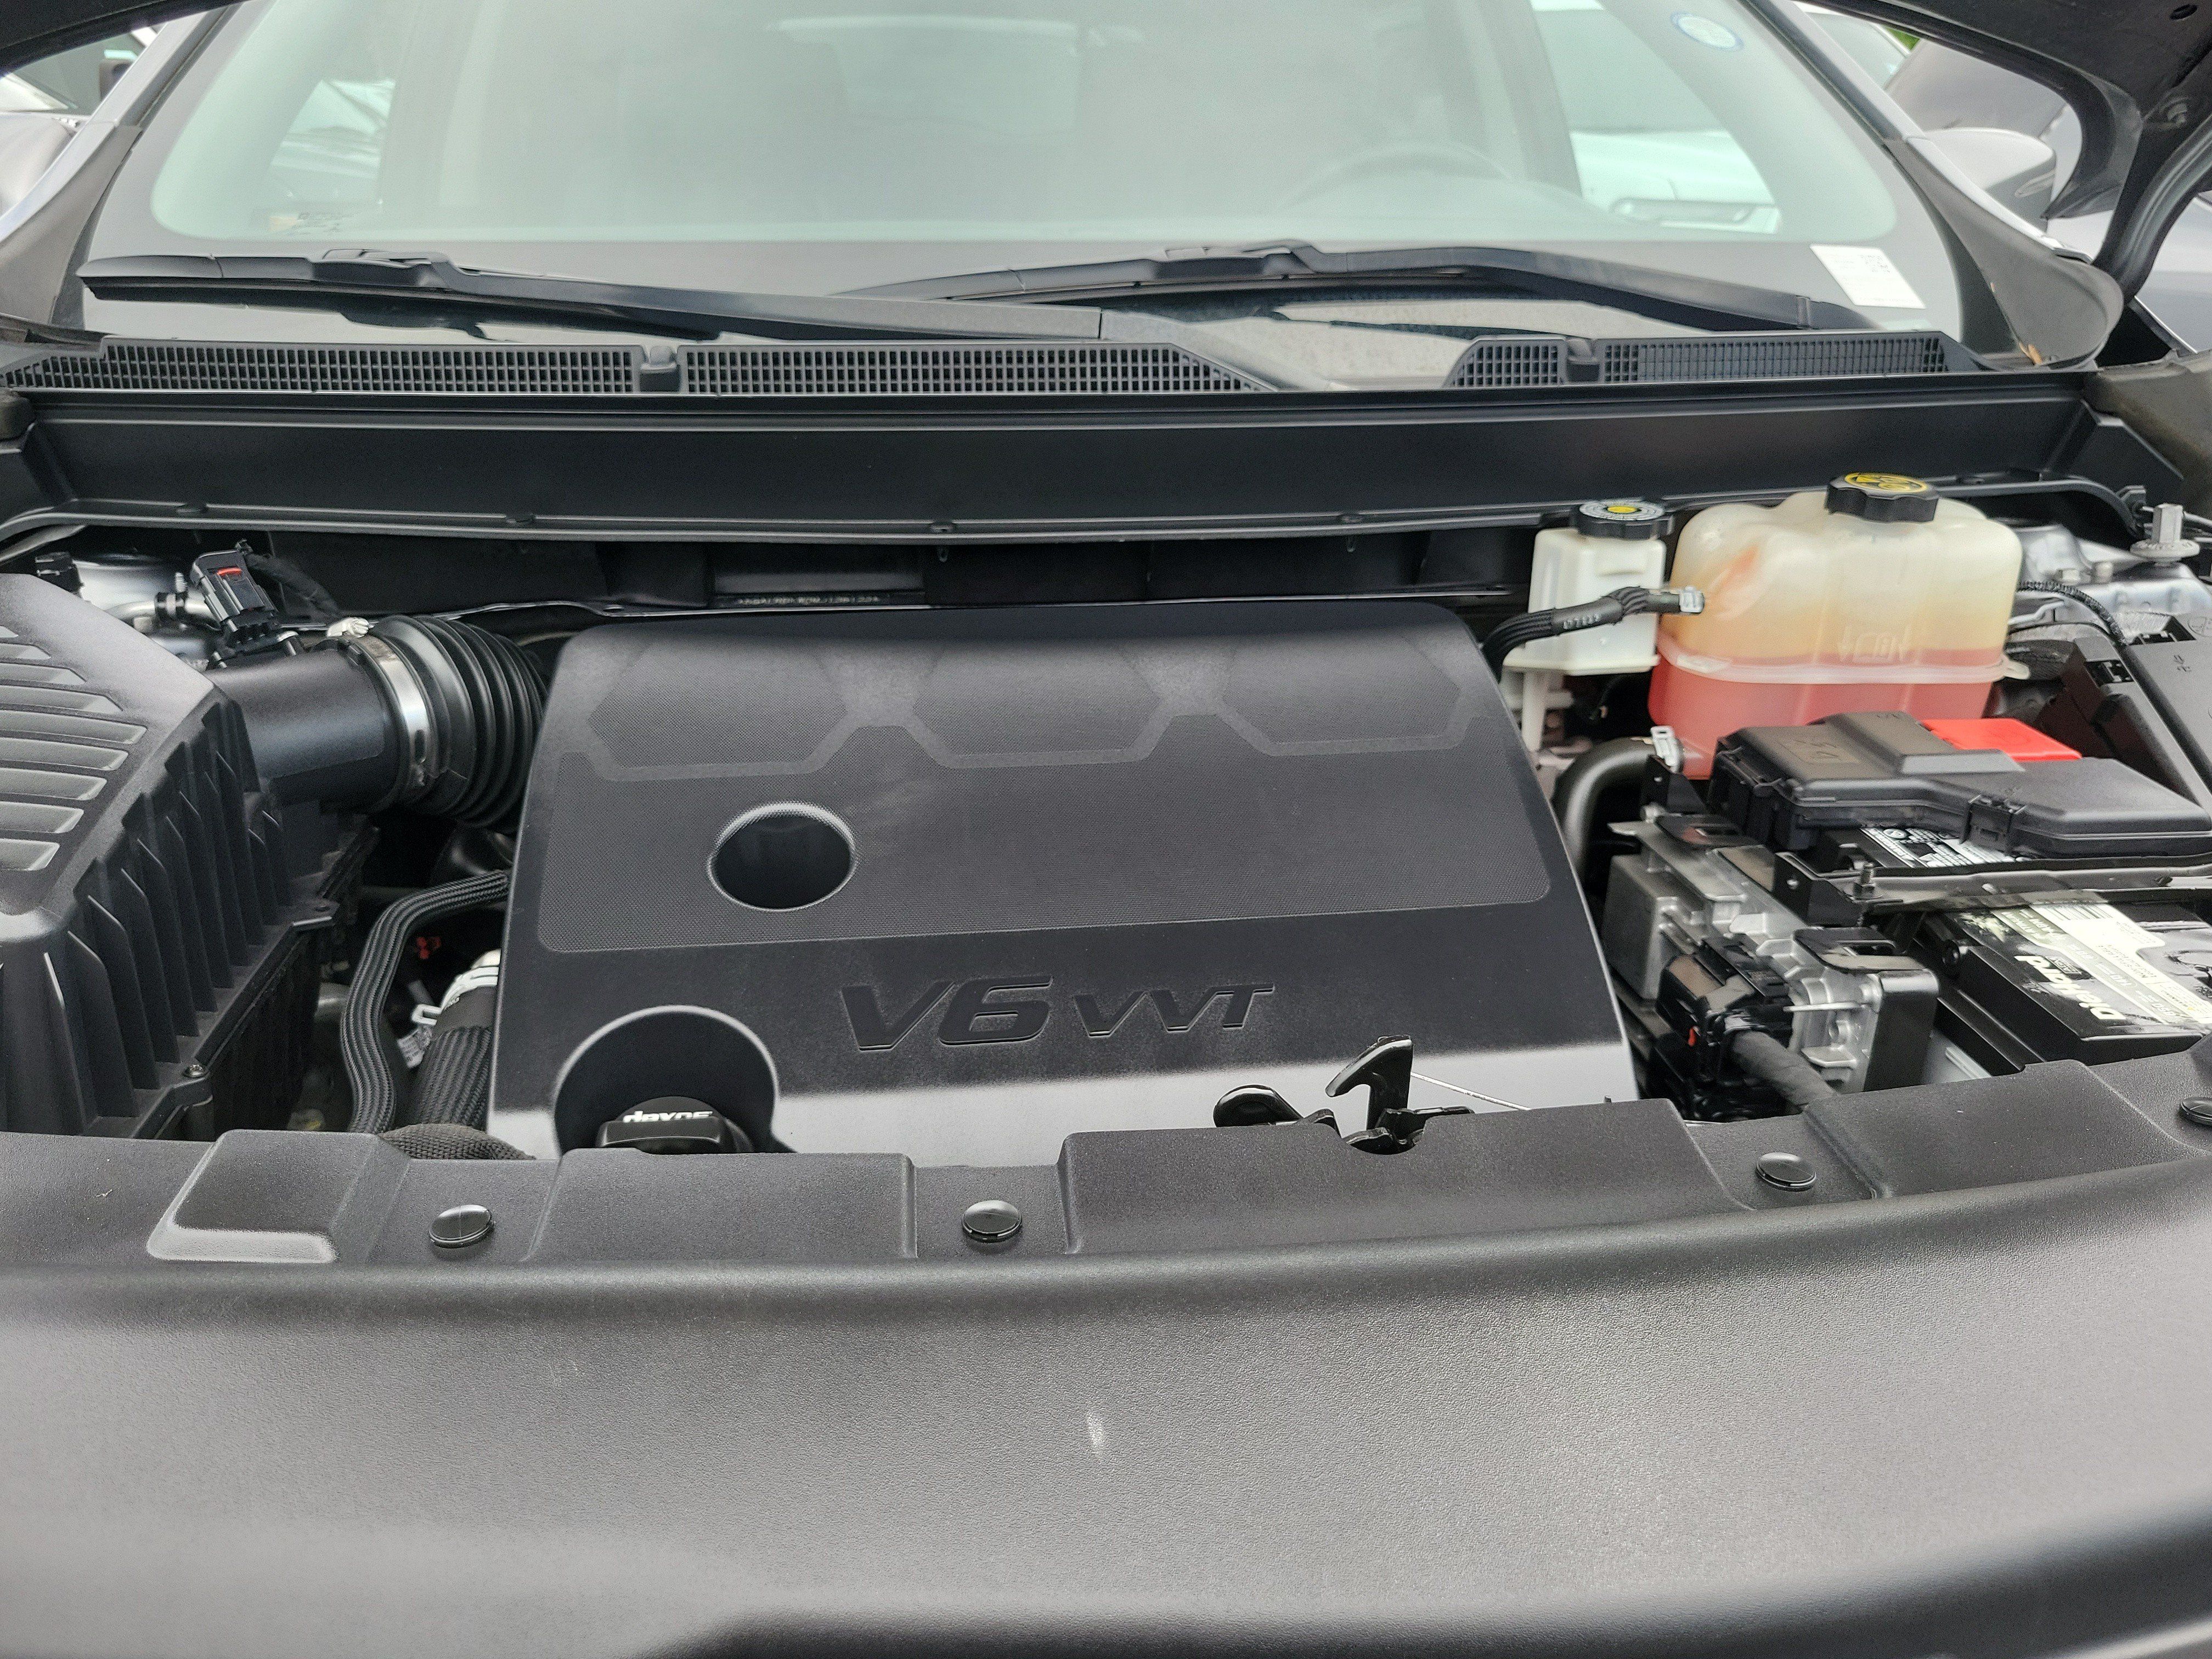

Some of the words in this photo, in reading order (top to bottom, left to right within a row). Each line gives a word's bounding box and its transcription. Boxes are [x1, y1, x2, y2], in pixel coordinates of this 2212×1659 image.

[840, 976, 1053, 1051] V6
[1074, 983, 1274, 1037] VVT
[2014, 956, 2126, 1019] DieHard
